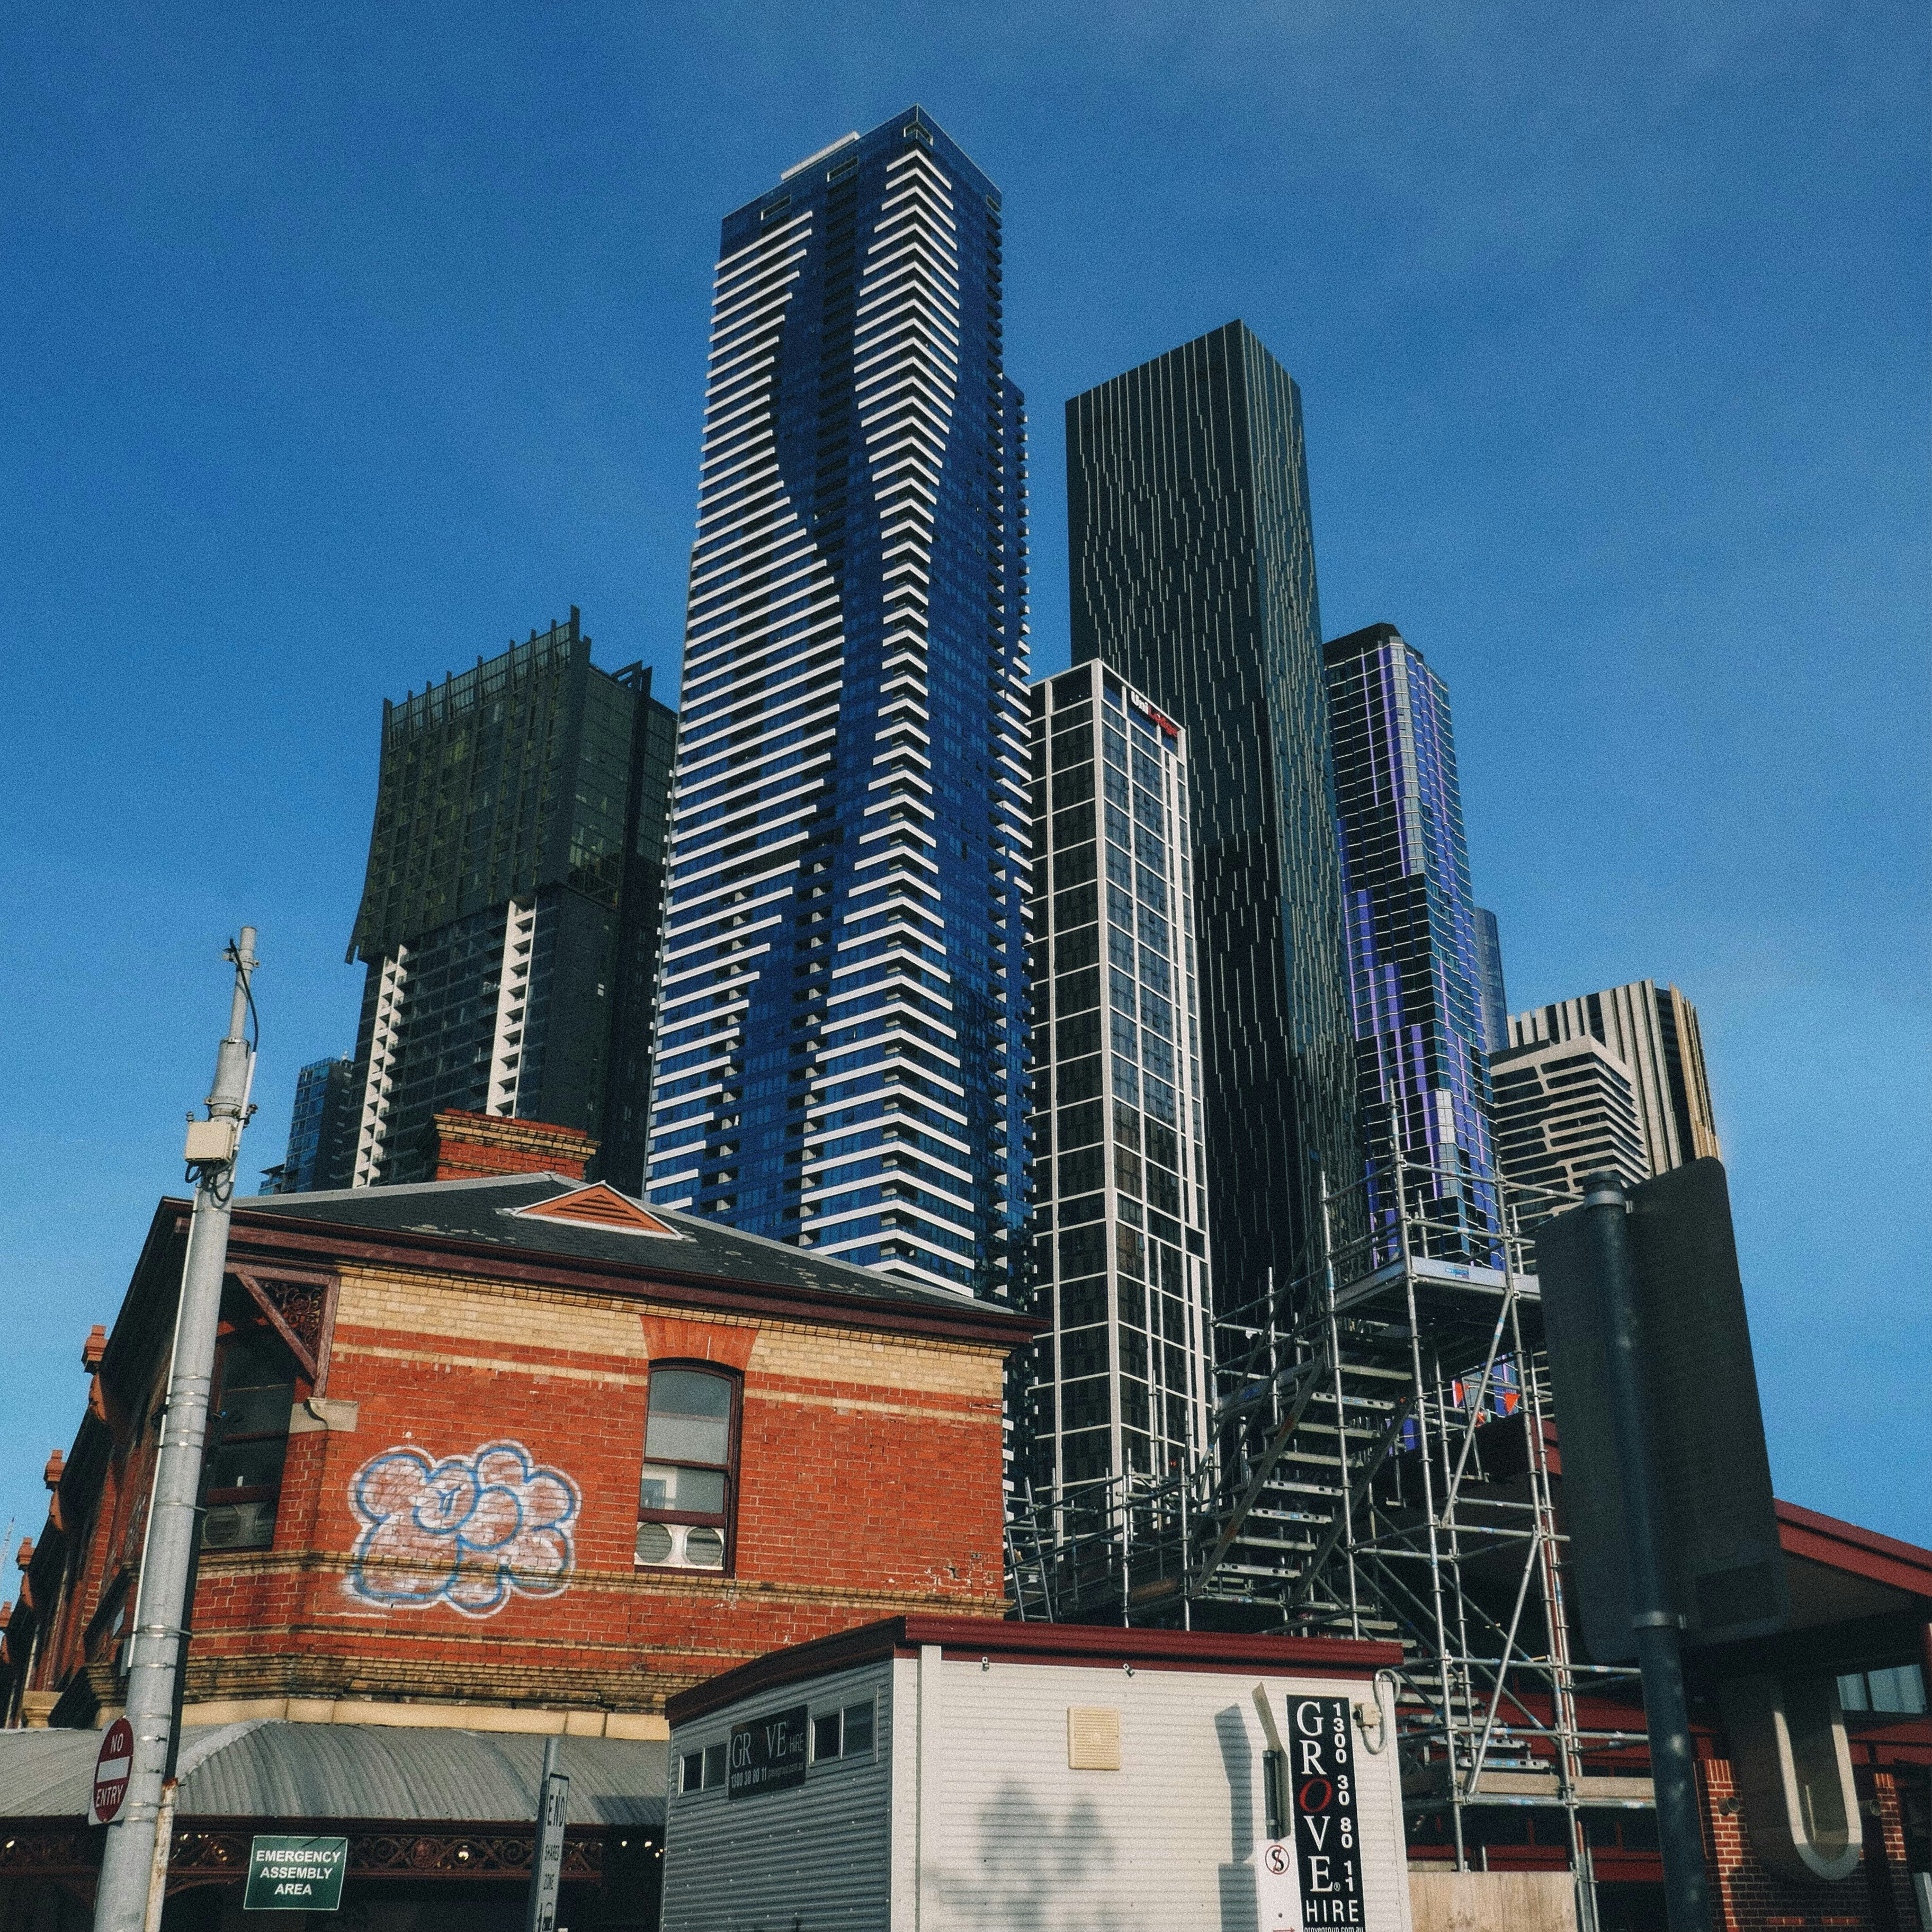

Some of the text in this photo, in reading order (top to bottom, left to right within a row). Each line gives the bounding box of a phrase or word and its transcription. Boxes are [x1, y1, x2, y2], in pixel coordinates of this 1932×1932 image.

[110, 1733, 124, 1754] NO
[732, 1721, 787, 1768] GRVE
[95, 1784, 124, 1808] ENTRY
[1333, 1703, 1354, 1892] 1300 30 80 11
[547, 1794, 565, 1827] END
[256, 1850, 340, 1863] EMERGENCY
[260, 1867, 333, 1880] ASSEMBLY
[274, 1884, 312, 1895] AREA
[1306, 1899, 1359, 1922] HIRE
